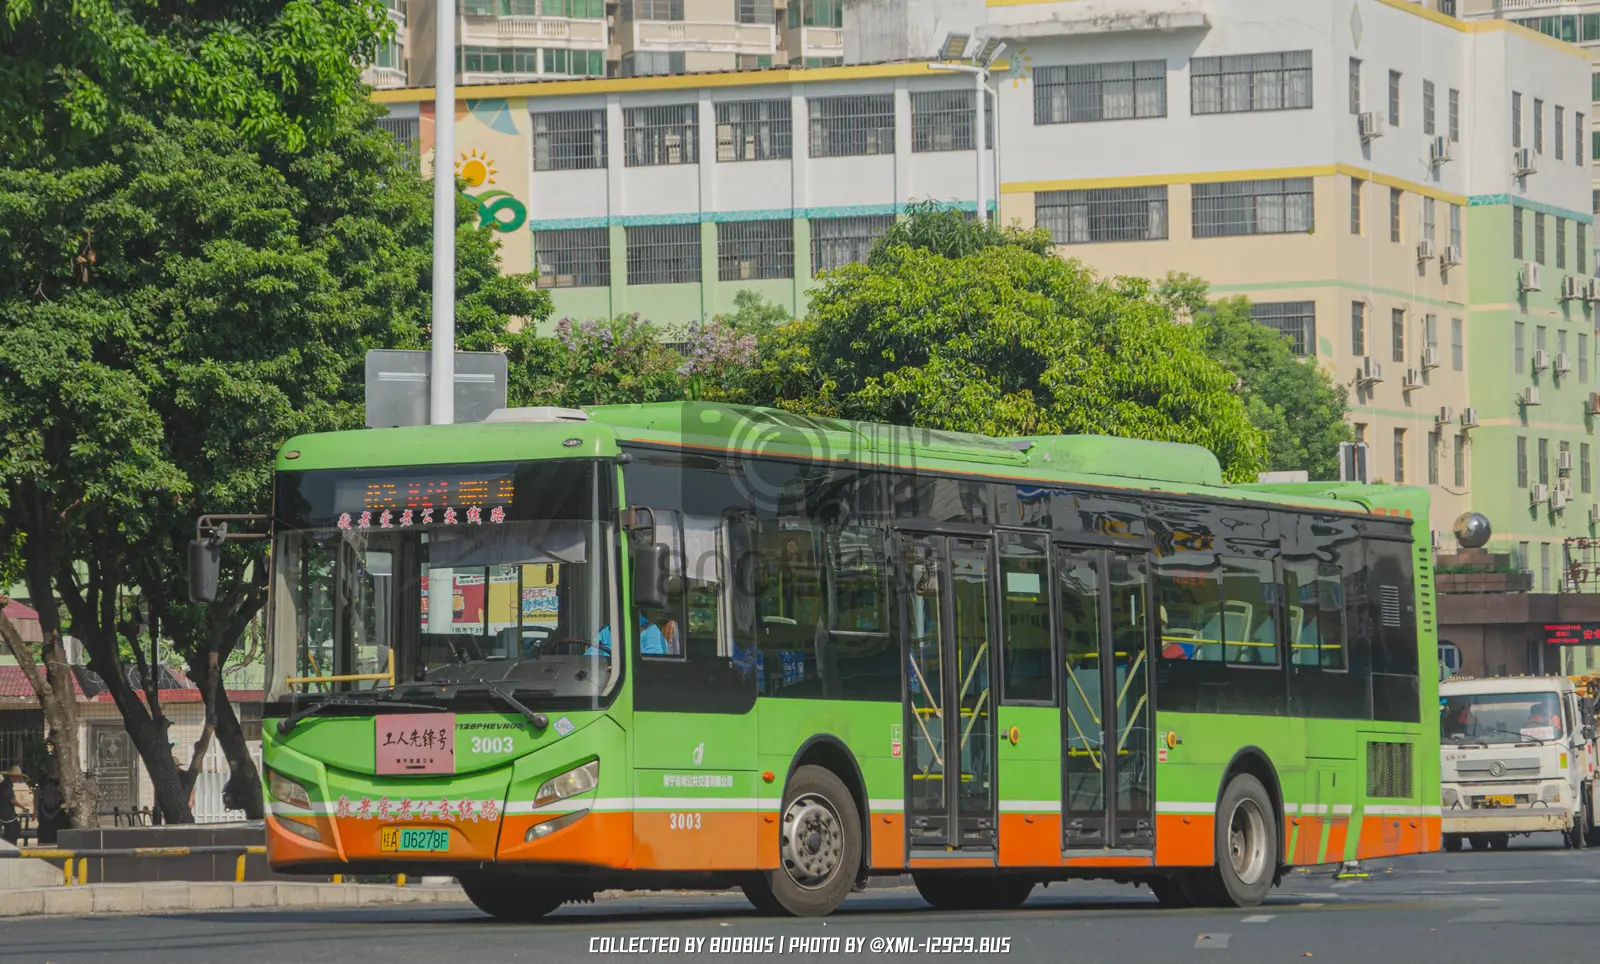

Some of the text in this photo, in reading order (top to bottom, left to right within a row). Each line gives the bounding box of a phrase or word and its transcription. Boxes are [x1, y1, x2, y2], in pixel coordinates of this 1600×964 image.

[338, 506, 506, 530] 敬老爱老公交线路
[383, 729, 448, 750] 工人先锋号
[471, 736, 514, 753] 3003
[337, 795, 499, 823] 敬老爱老公交线路
[670, 813, 702, 830] 3003
[403, 831, 449, 849] 06278F
